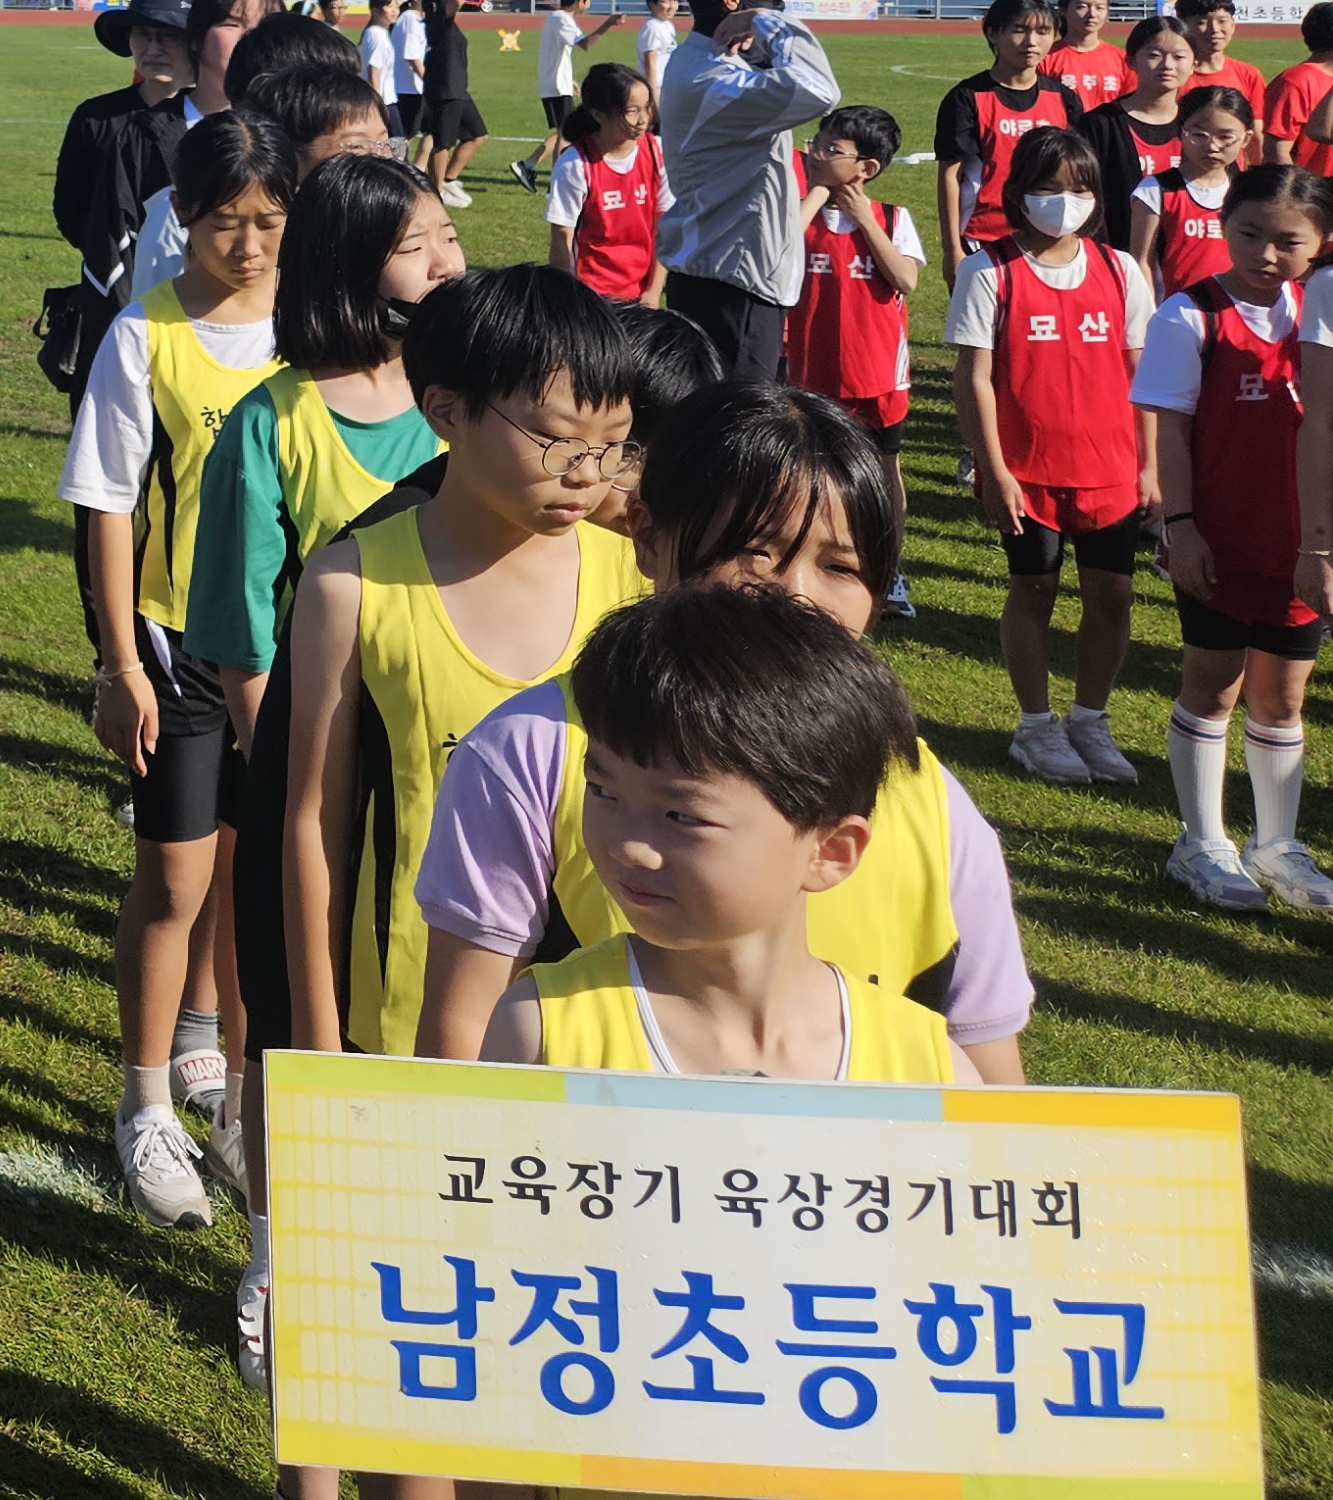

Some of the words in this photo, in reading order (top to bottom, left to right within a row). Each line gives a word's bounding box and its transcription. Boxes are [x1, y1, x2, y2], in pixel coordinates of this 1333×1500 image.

[807, 252, 874, 279] 묘산
[1027, 311, 1110, 342] 묘산
[438, 1153, 682, 1224] 교육장기
[714, 1168, 1082, 1240] 육상경기대회
[369, 1254, 1166, 1435] 남정초등학교
